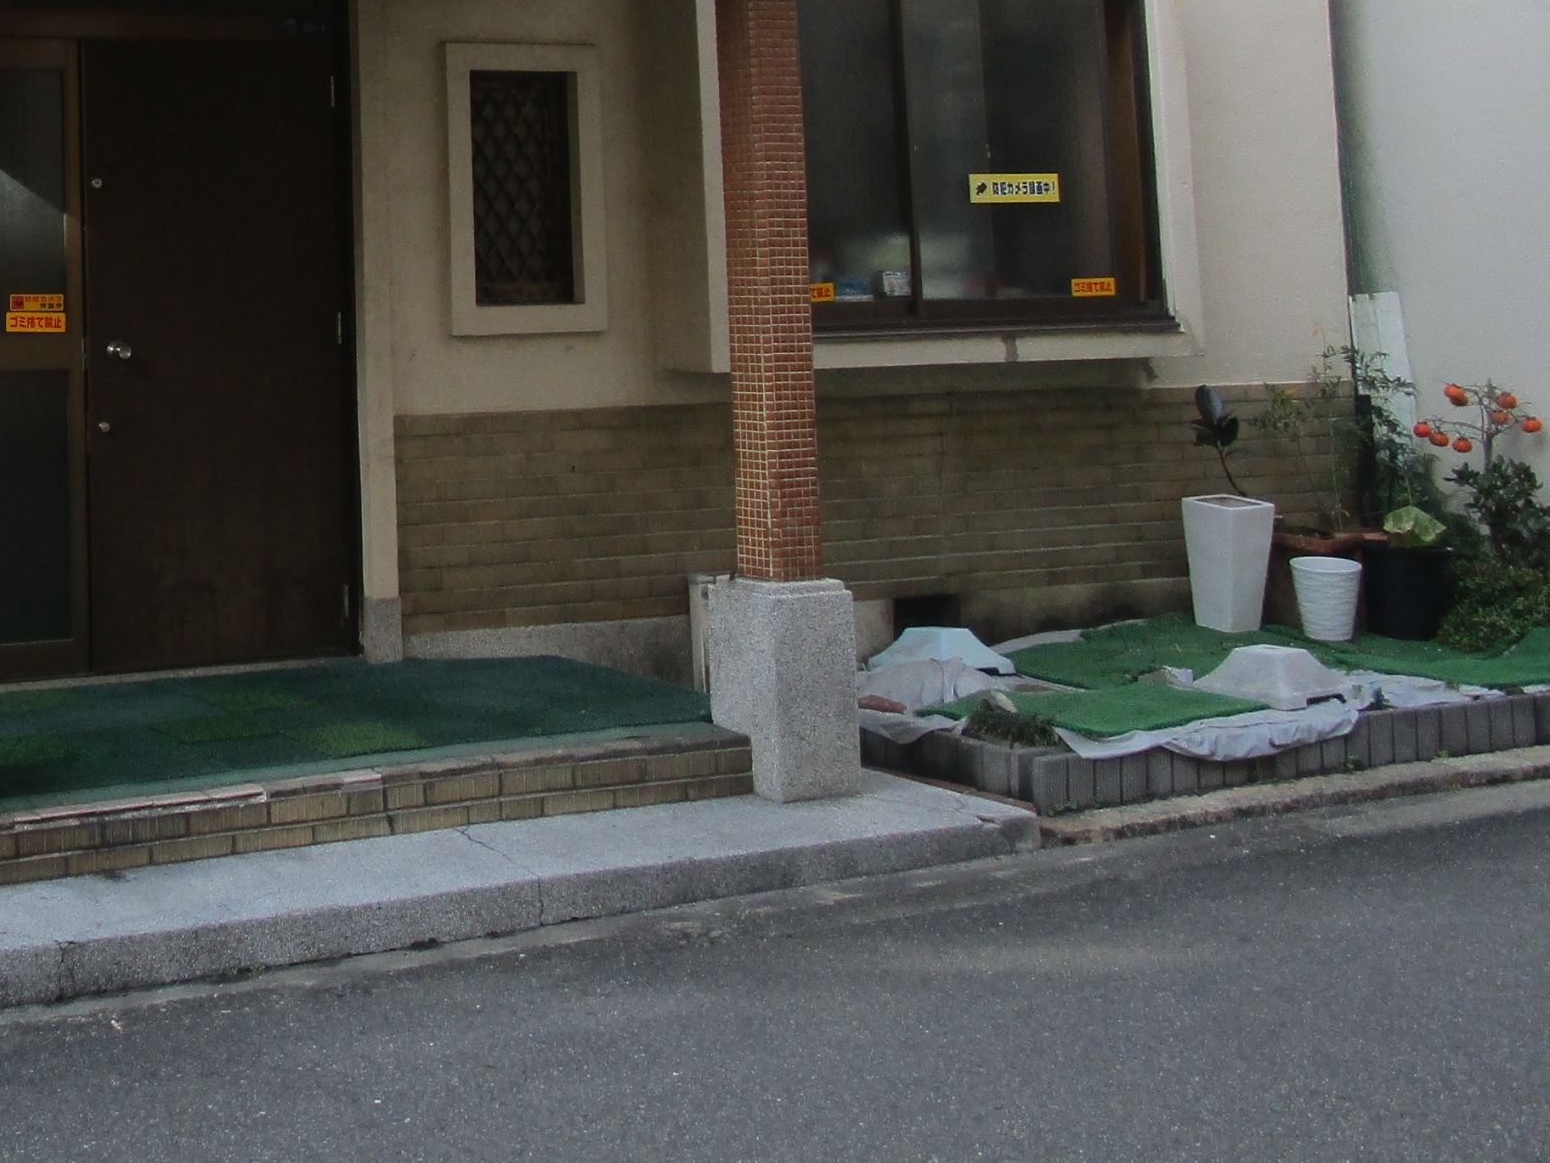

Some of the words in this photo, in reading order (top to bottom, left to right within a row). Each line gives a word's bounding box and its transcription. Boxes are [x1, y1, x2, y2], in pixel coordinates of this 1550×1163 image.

[9, 315, 62, 329] ゴミ捨て禁止
